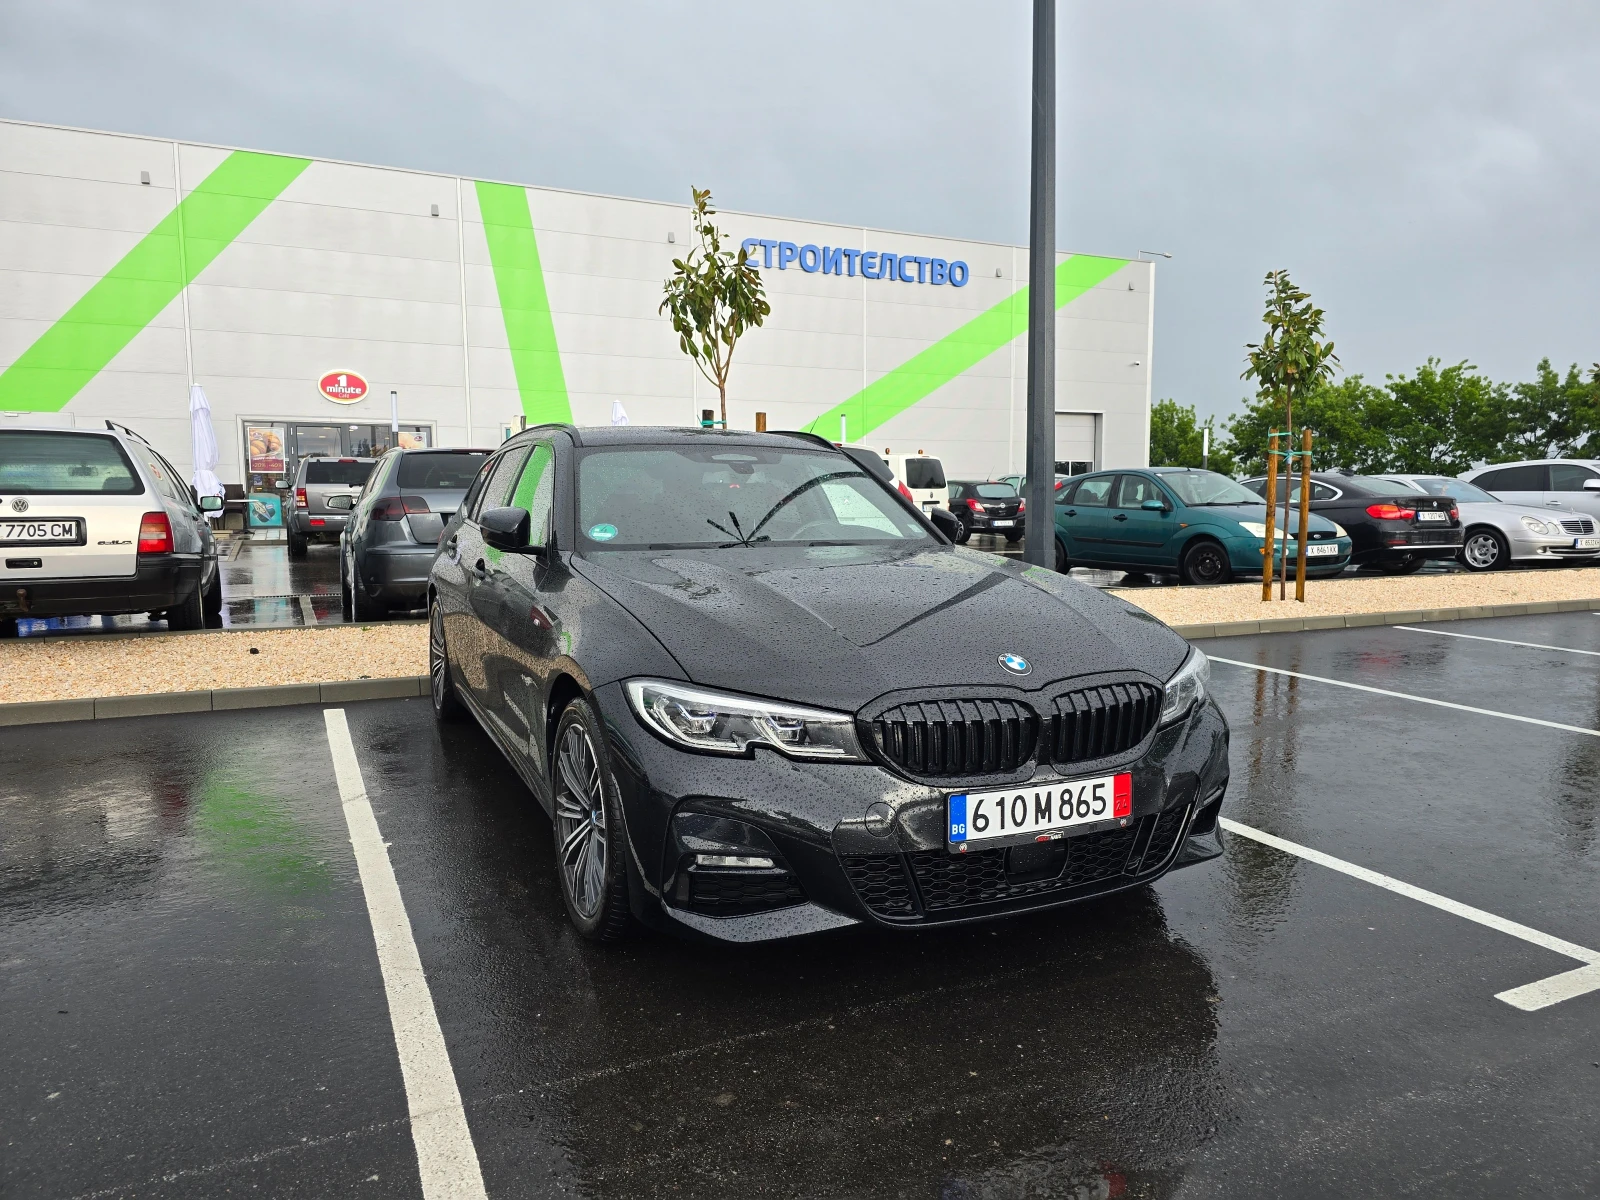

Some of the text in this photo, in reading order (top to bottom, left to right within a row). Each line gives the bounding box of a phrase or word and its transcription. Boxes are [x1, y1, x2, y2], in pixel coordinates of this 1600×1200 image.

[741, 238, 969, 287] СТРОИТЕЛСТВО
[337, 374, 347, 386] 1
[326, 384, 362, 394] minute
[5, 523, 73, 537] 7705 CM
[952, 824, 965, 835] BG
